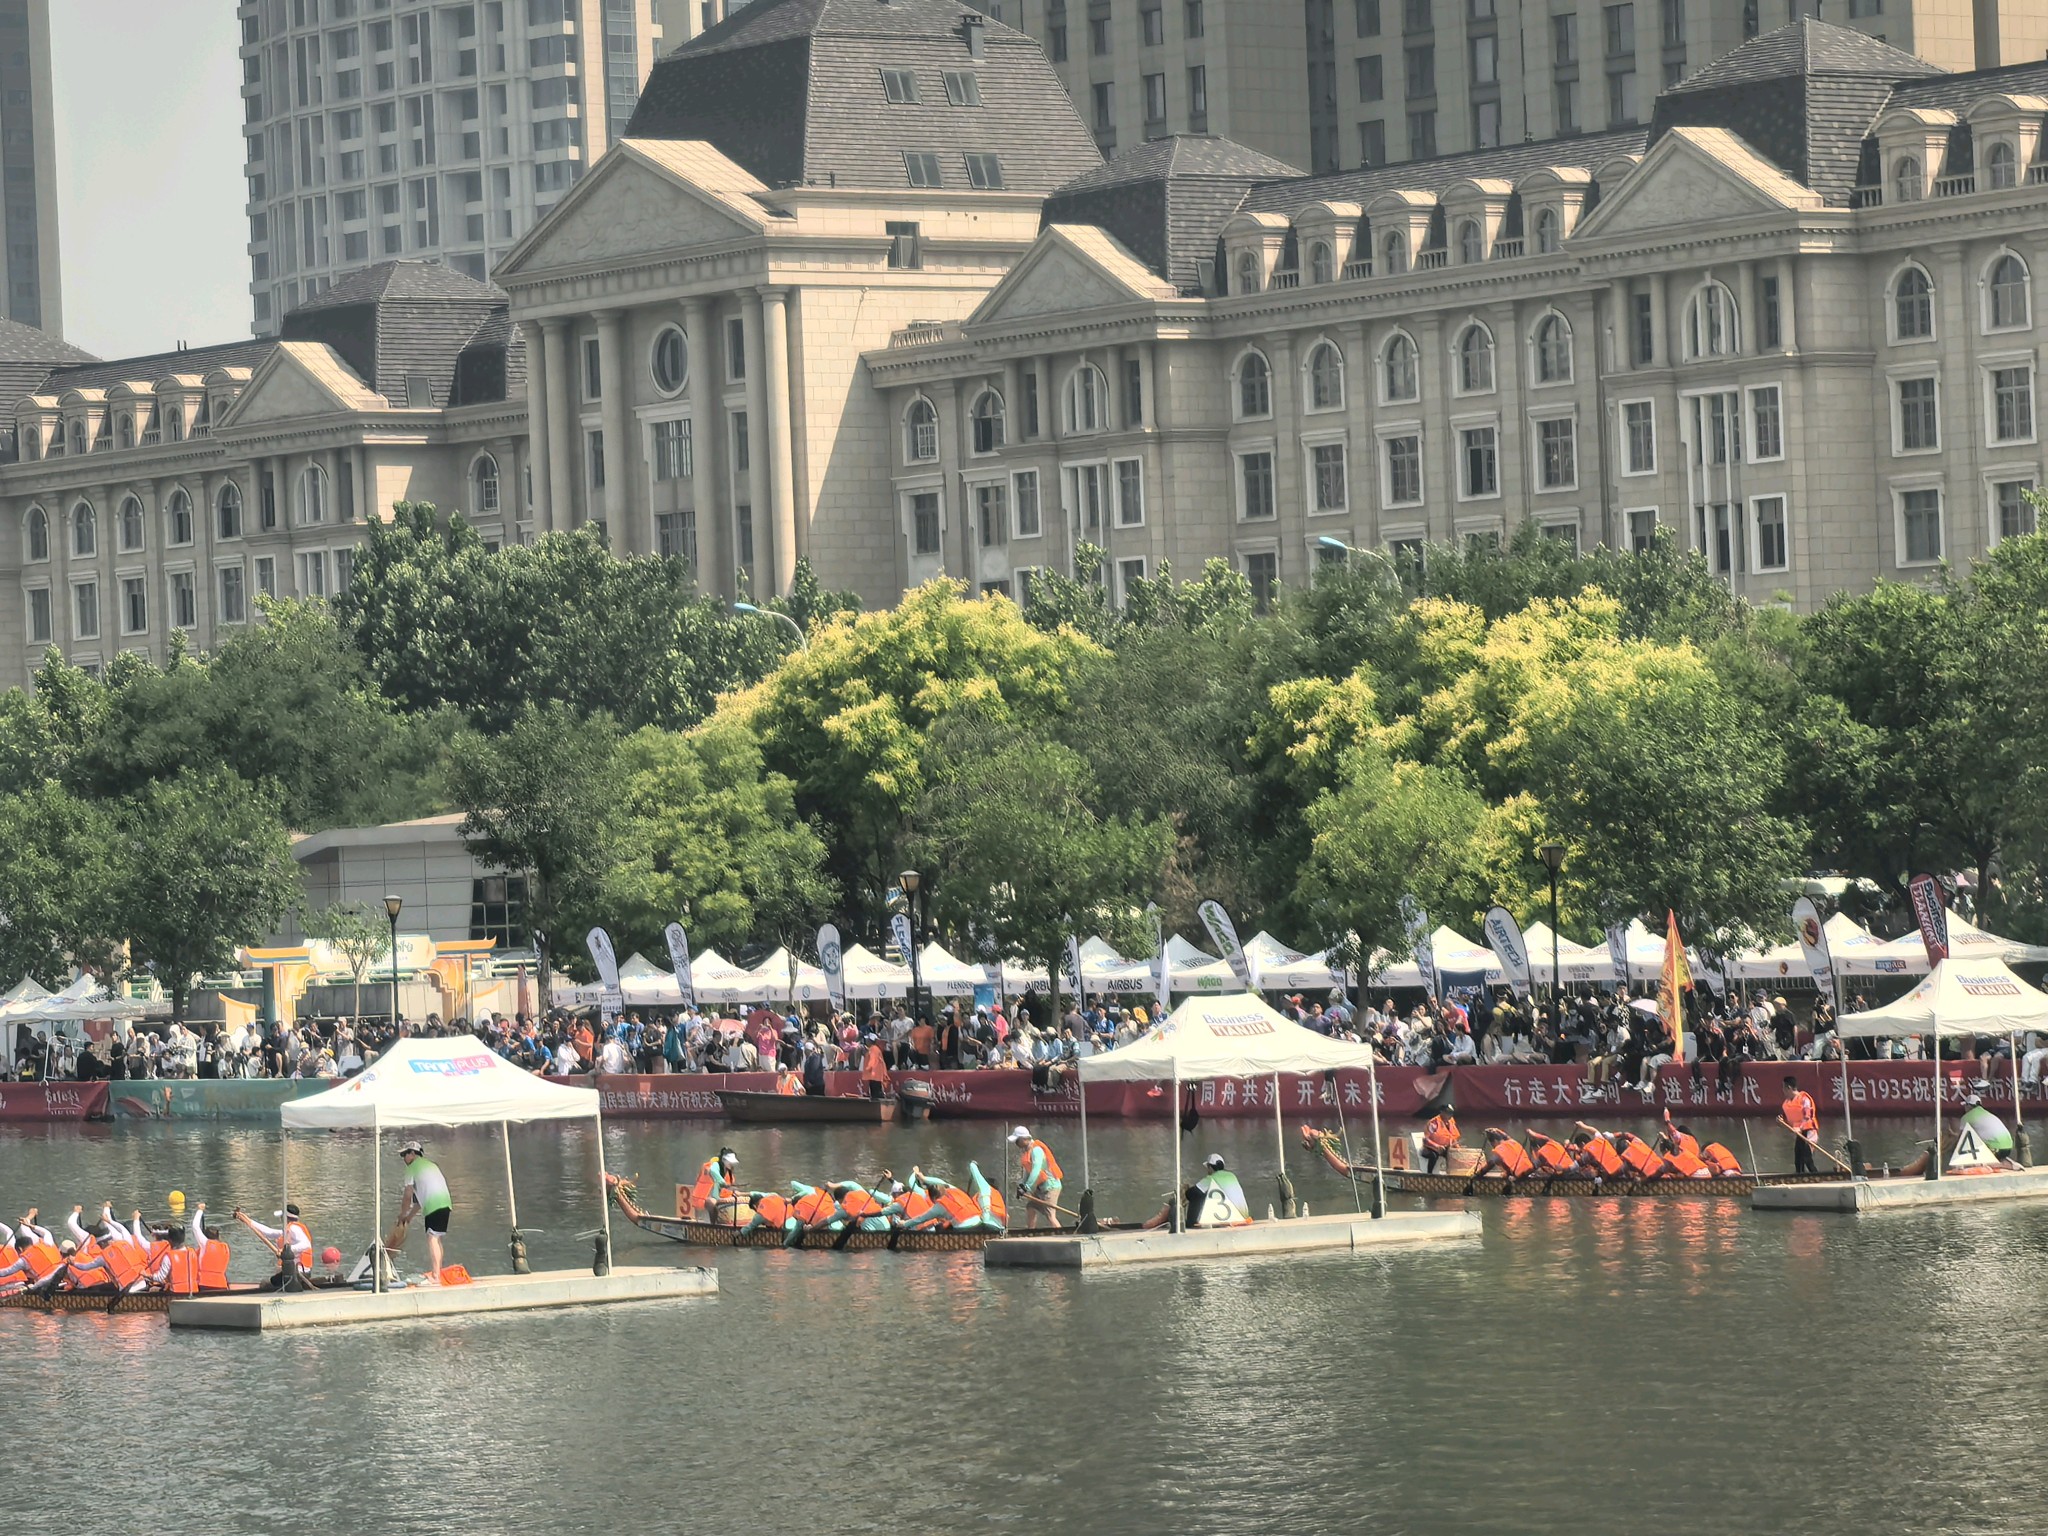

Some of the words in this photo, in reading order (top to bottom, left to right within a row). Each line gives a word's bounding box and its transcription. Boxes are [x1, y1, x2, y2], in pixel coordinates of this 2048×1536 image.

[1911, 884, 1938, 948] TIANJIN
[1924, 881, 1947, 944] Business
[1488, 918, 1523, 967] AIRTECH
[1024, 980, 1052, 992] AIRBU
[1107, 978, 1143, 991] AIRBUS
[1955, 974, 2011, 984] Business
[1965, 984, 2017, 995] TIANJIN
[1202, 1013, 1264, 1024] Business
[1214, 1022, 1272, 1036] TIANJIN
[457, 1056, 489, 1069] PLUS
[1392, 1138, 1406, 1165] 4
[1958, 1130, 1980, 1161] 4
[679, 1186, 692, 1216] 3
[1208, 1189, 1232, 1222] 3
